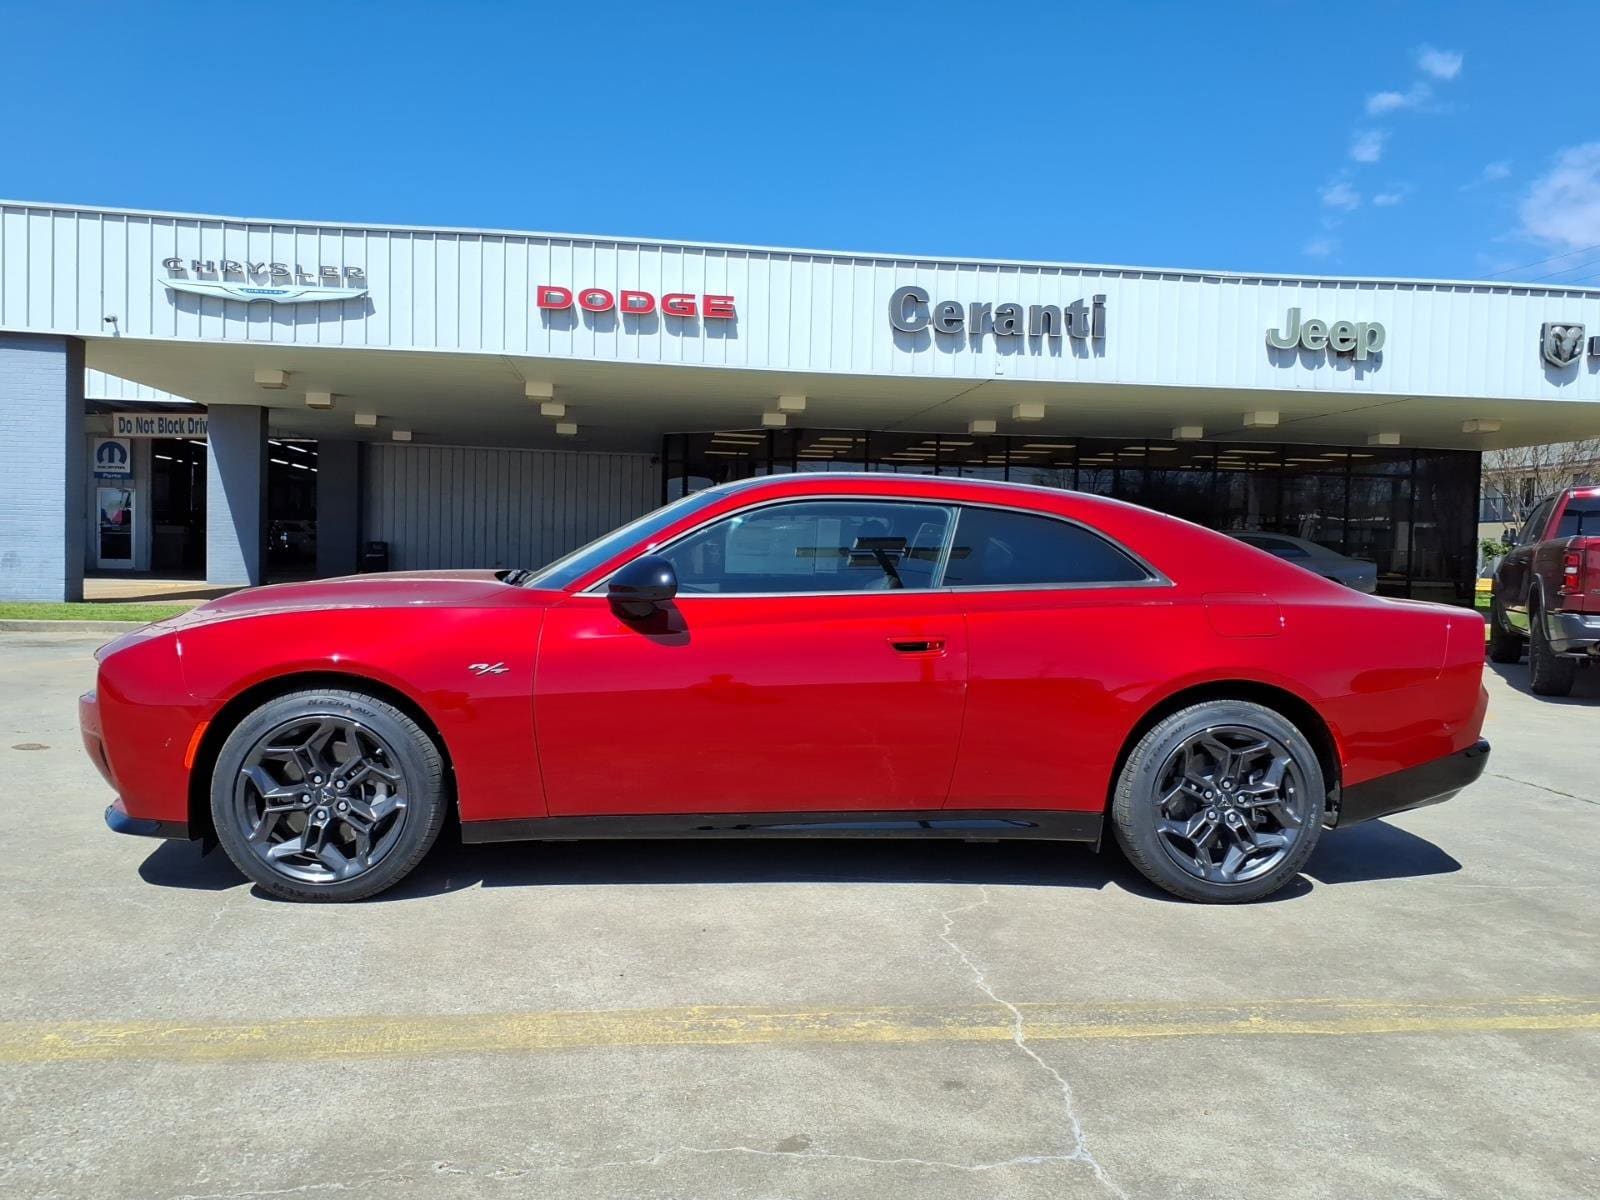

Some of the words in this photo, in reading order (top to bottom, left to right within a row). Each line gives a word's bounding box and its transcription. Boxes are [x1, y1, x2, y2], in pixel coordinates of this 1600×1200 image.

[162, 257, 364, 279] CHRYSLER
[536, 285, 735, 319] DODGE
[888, 285, 1107, 338] Ceranti
[1265, 307, 1386, 361] Jeep
[118, 416, 132, 434] Do
[136, 416, 155, 434] Not
[158, 416, 185, 434] Block
